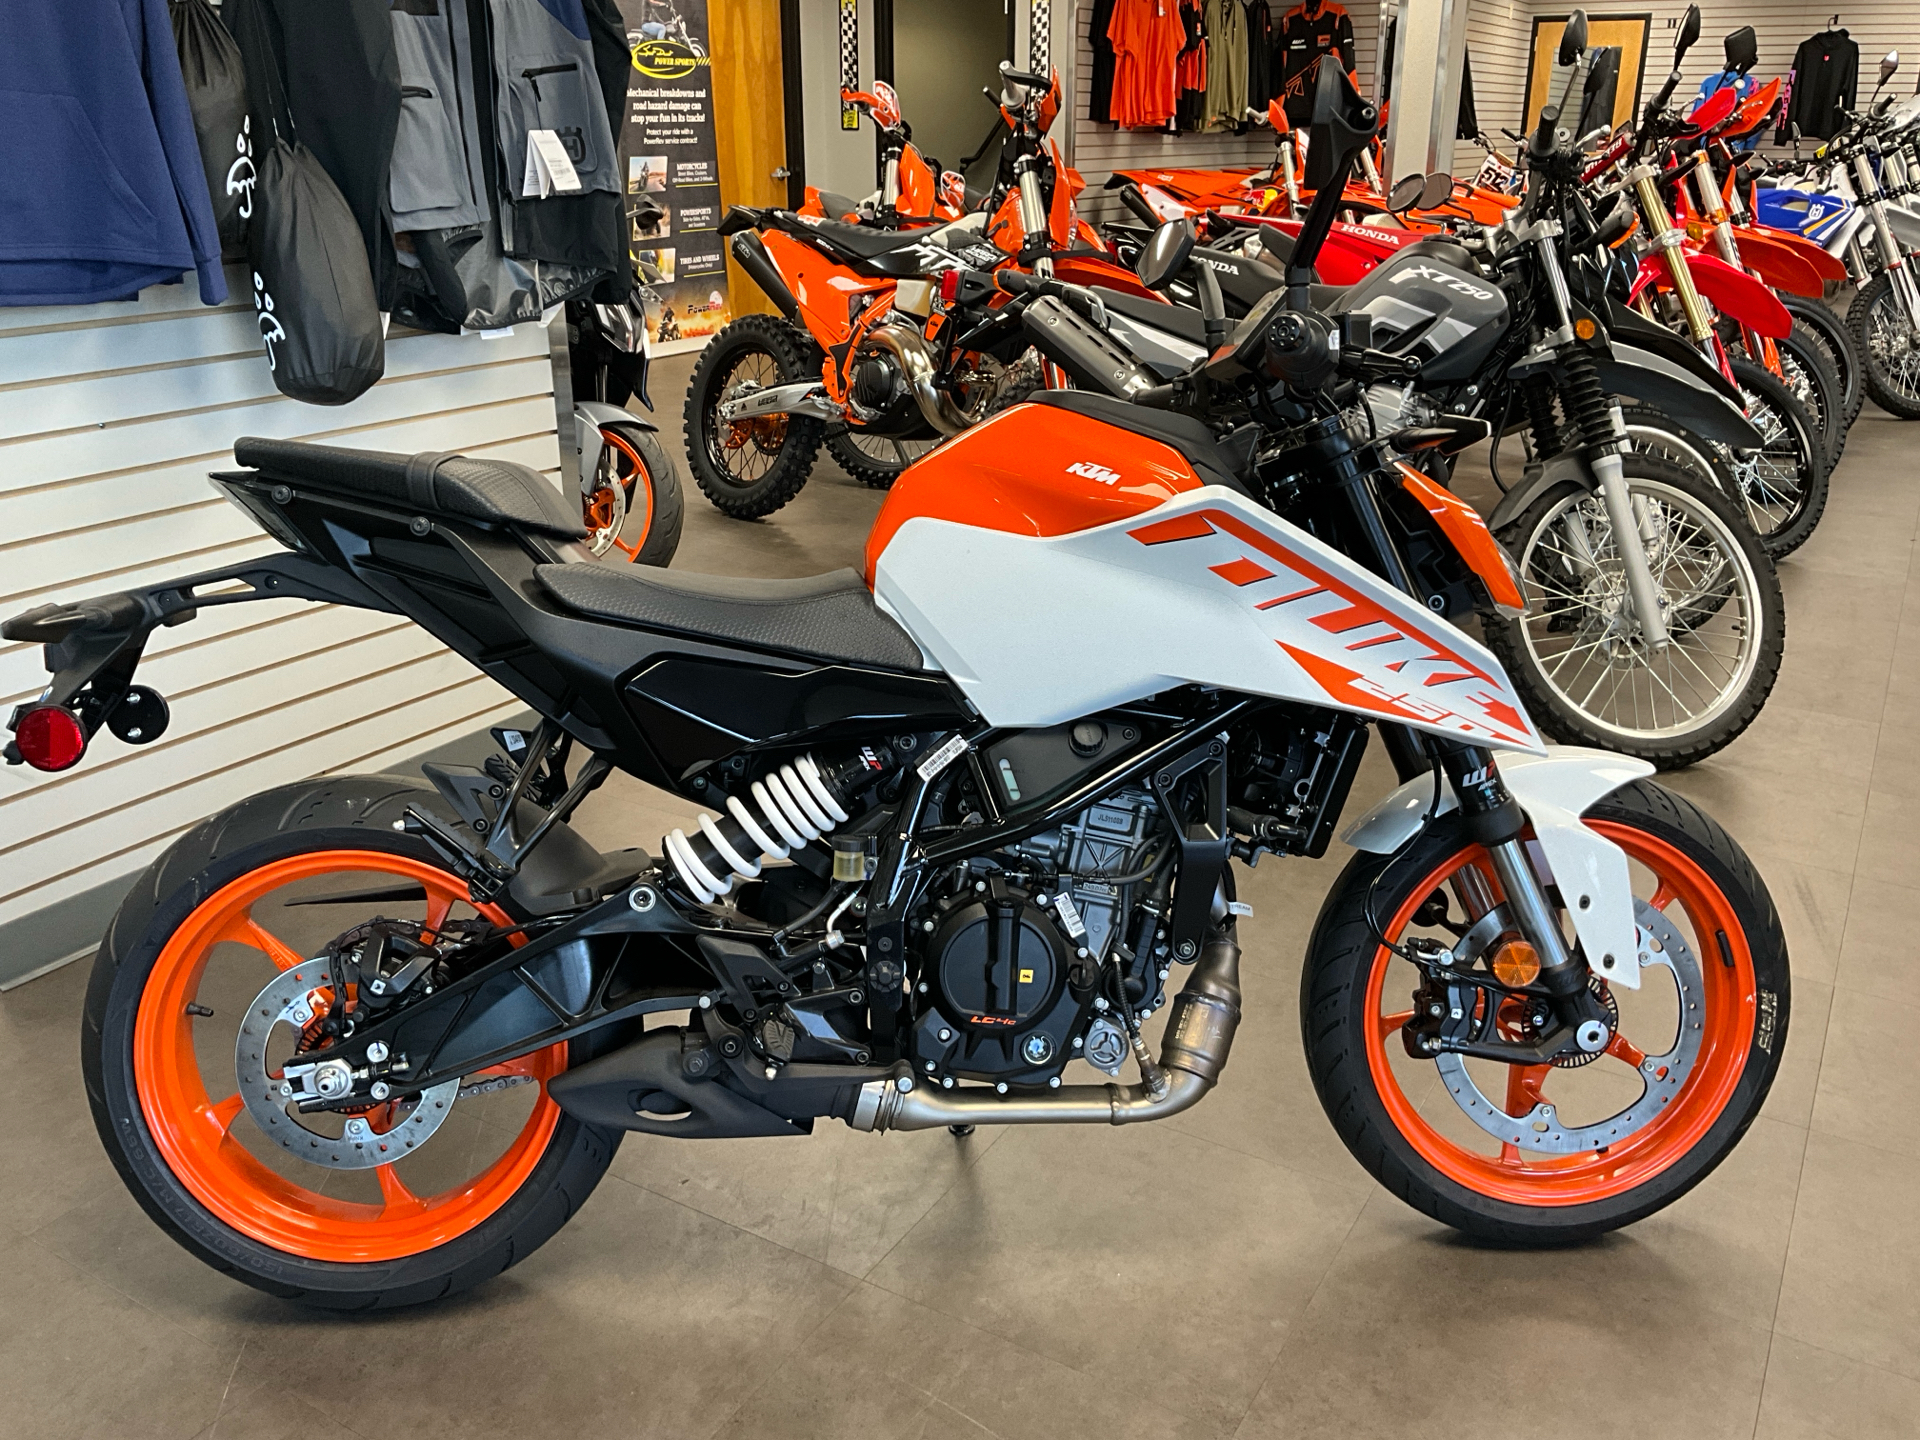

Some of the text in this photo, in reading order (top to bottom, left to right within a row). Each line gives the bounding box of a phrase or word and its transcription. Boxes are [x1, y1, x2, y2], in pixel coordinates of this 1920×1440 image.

[660, 88, 694, 98] breakdowns
[695, 88, 706, 98] and
[633, 100, 702, 112] road hazard damage can
[631, 114, 644, 125] stop
[645, 115, 658, 125] your
[660, 113, 670, 122] fun
[671, 113, 677, 122] in
[646, 128, 661, 136] Protect
[676, 162, 708, 170] MOTORCYCLES
[1341, 224, 1400, 245] HONDA
[680, 254, 720, 265] TIRES AND WHEELS
[1388, 264, 1494, 300] XT250
[1065, 461, 1122, 486] KTM
[861, 746, 883, 771] WP
[1462, 759, 1496, 788] WP
[1229, 903, 1252, 912] TREAM
